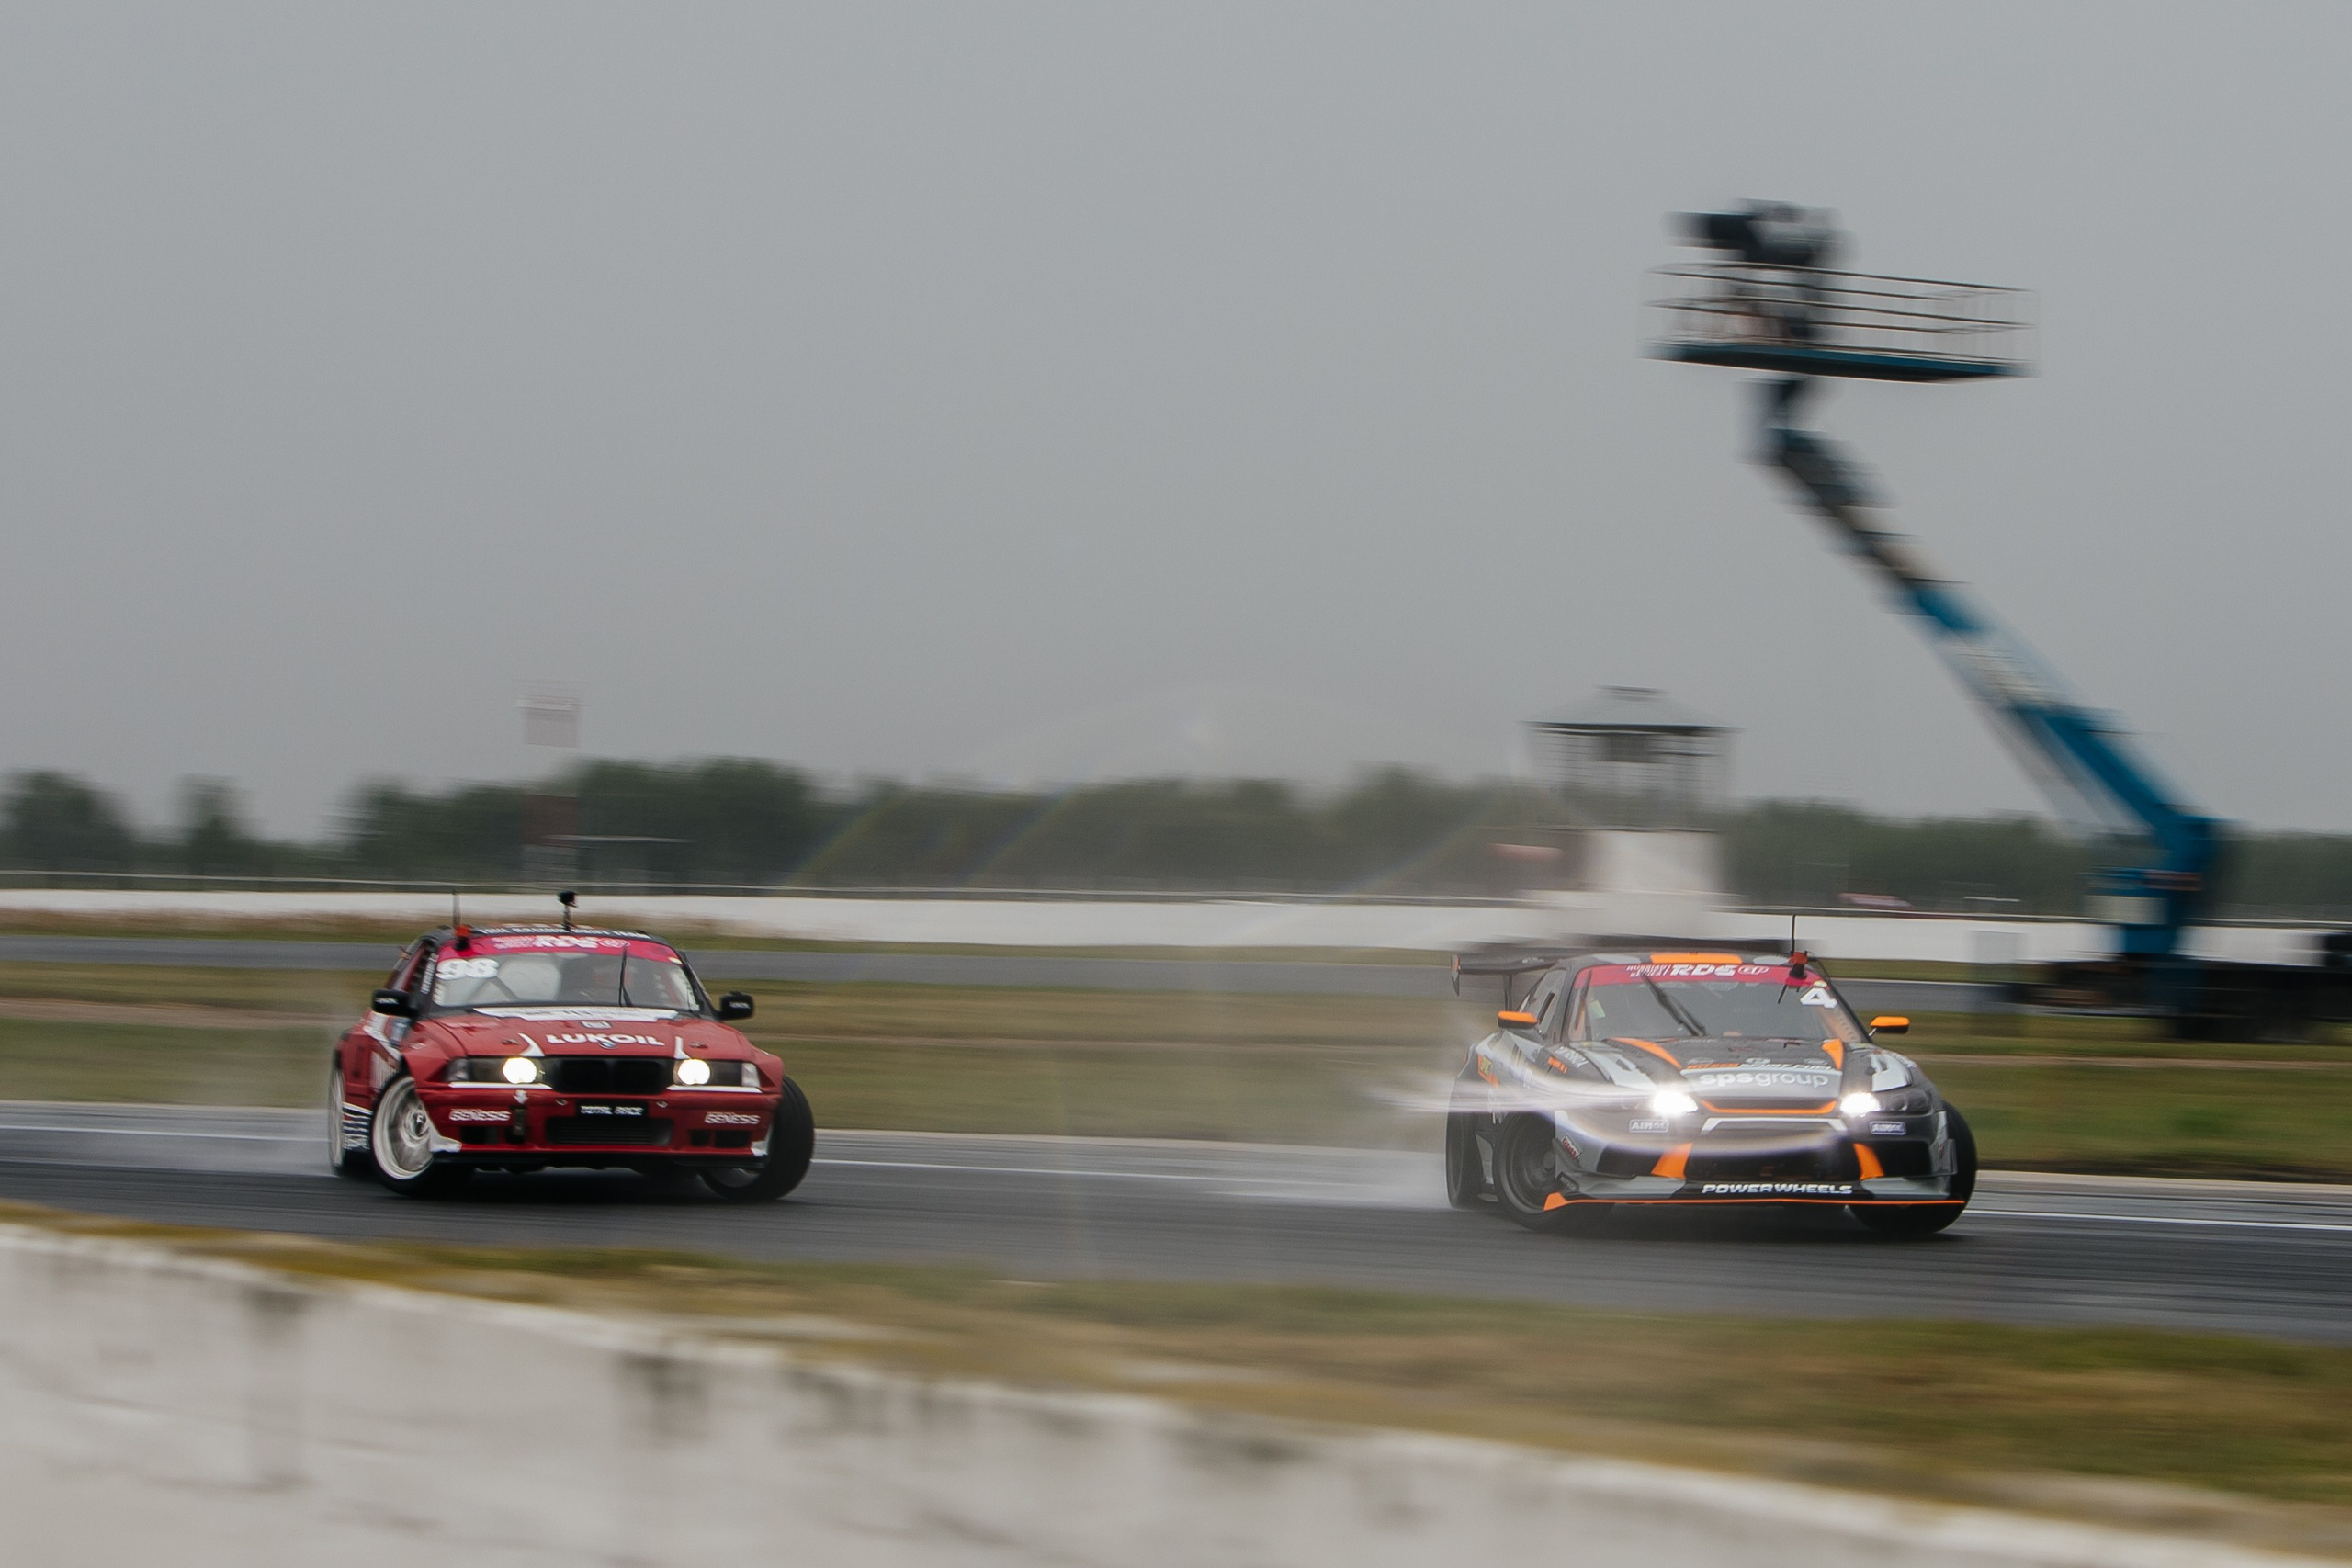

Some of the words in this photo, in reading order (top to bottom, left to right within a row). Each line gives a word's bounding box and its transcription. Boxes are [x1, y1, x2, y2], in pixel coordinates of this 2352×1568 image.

[435, 958, 500, 981] 98
[1670, 964, 1737, 976] RDS
[1799, 987, 1838, 1009] 4
[545, 1032, 665, 1046] LUKOIL
[1702, 1182, 1853, 1195] POWERWHEELS
